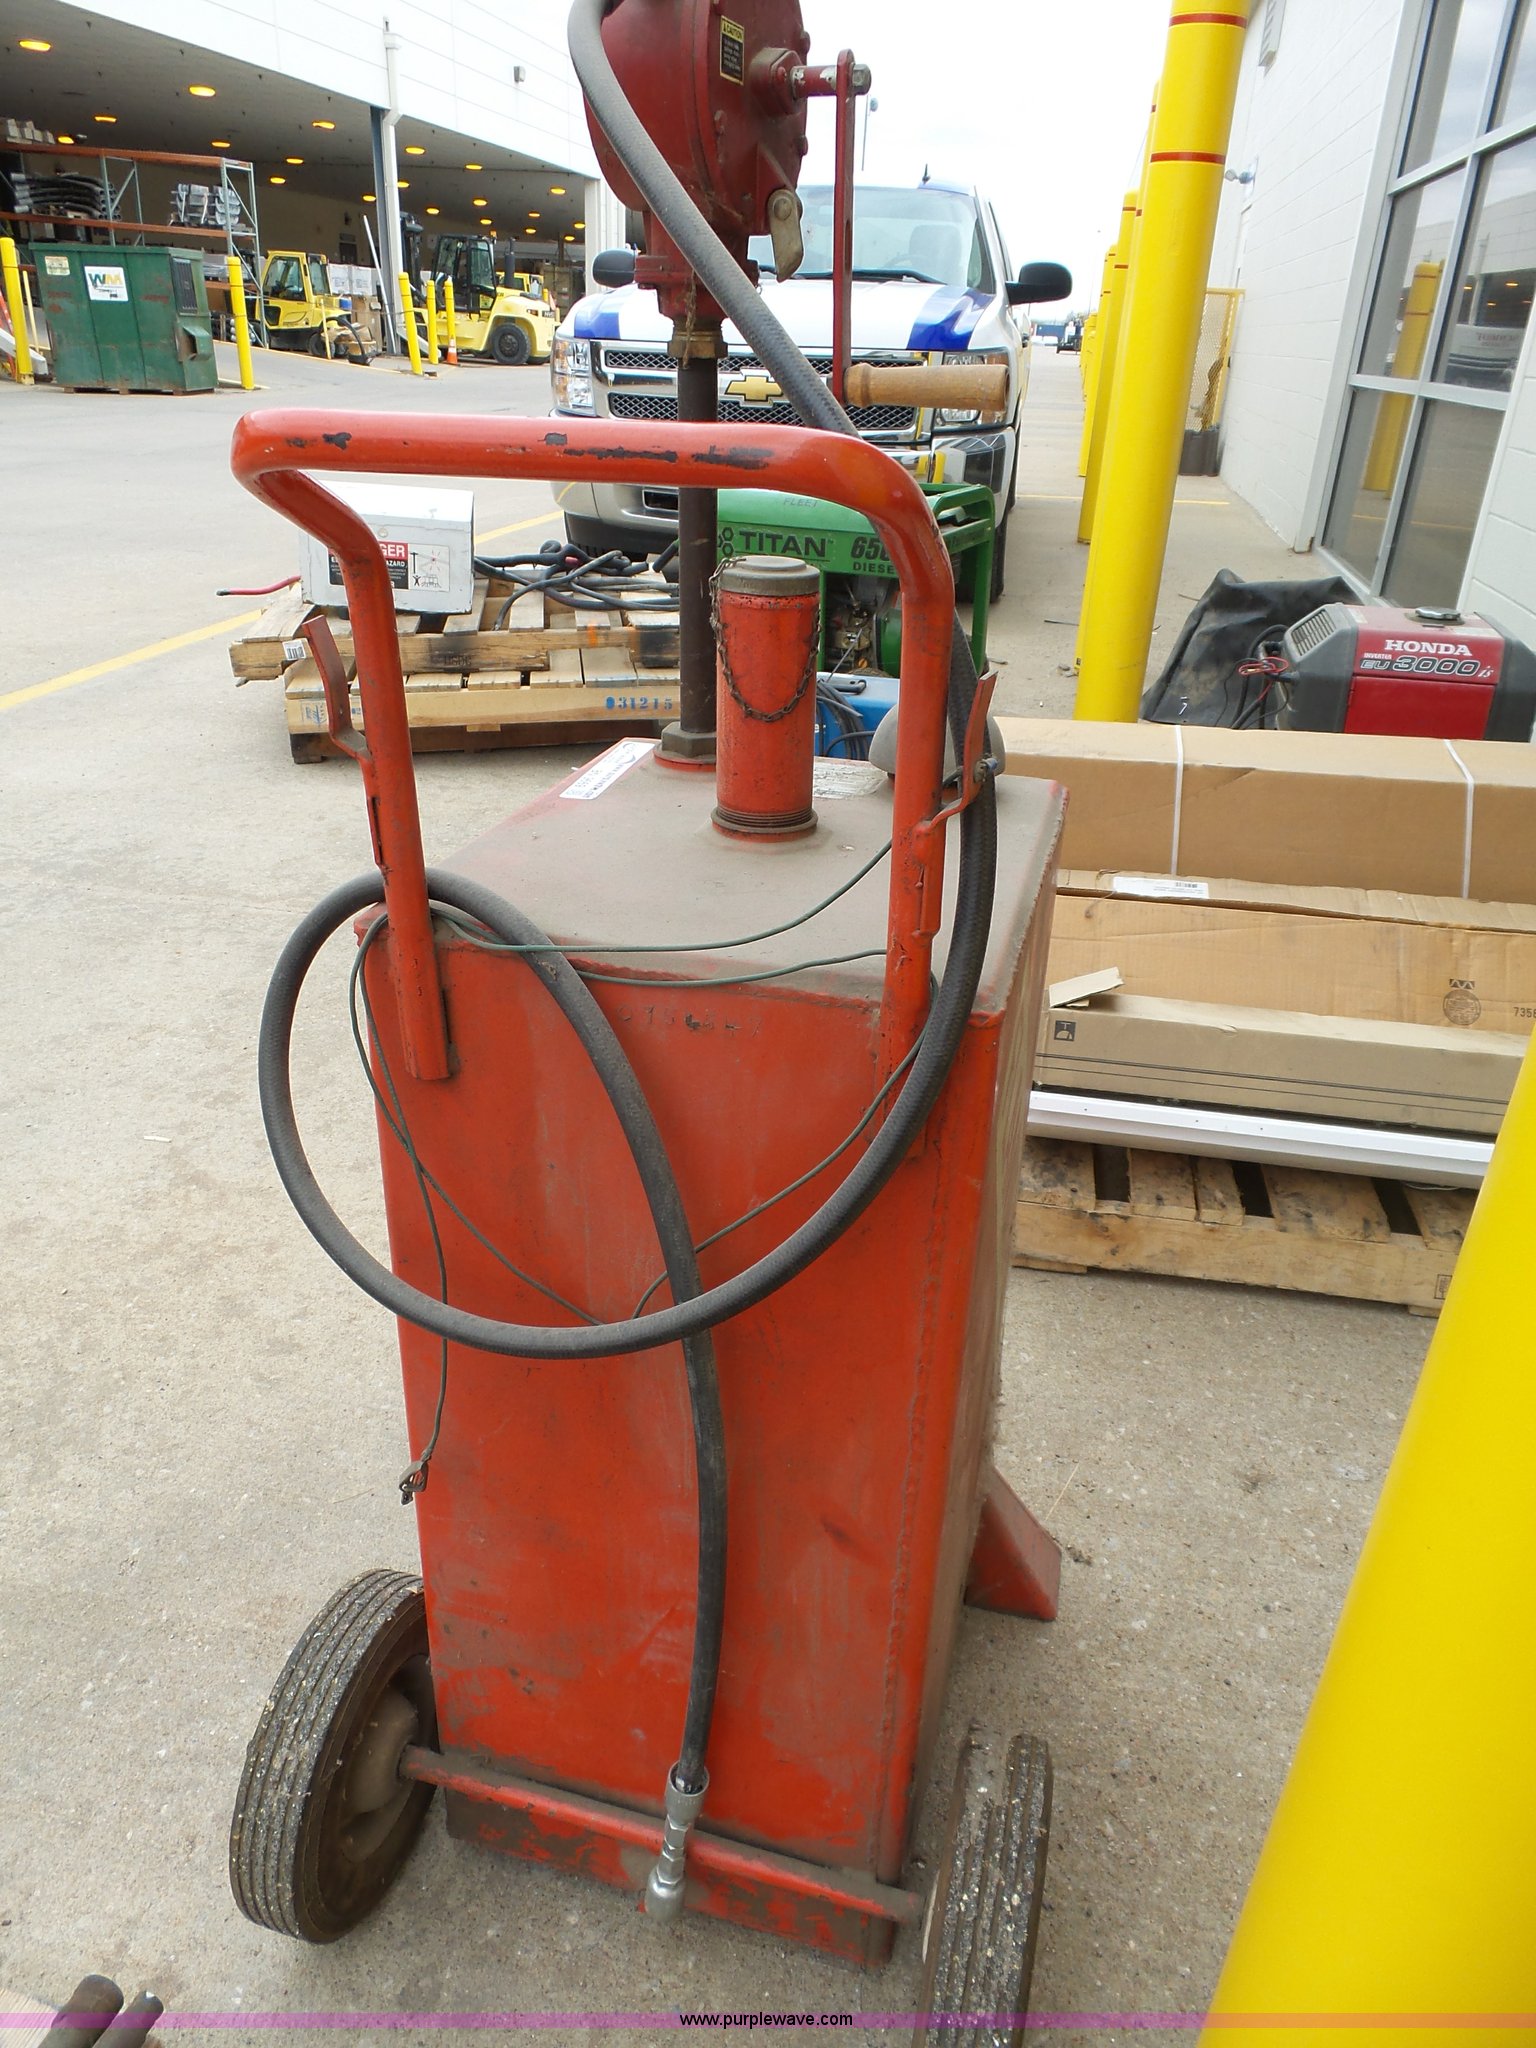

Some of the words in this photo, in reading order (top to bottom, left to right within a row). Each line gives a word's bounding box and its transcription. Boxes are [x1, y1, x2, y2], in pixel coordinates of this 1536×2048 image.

[378, 543, 406, 558] GER
[739, 530, 827, 557] TITAN
[851, 536, 894, 562] 650
[385, 559, 406, 568] AZARD
[853, 562, 895, 575] DIESE
[1384, 639, 1473, 657] HONDA
[1363, 652, 1392, 660] INVERTER
